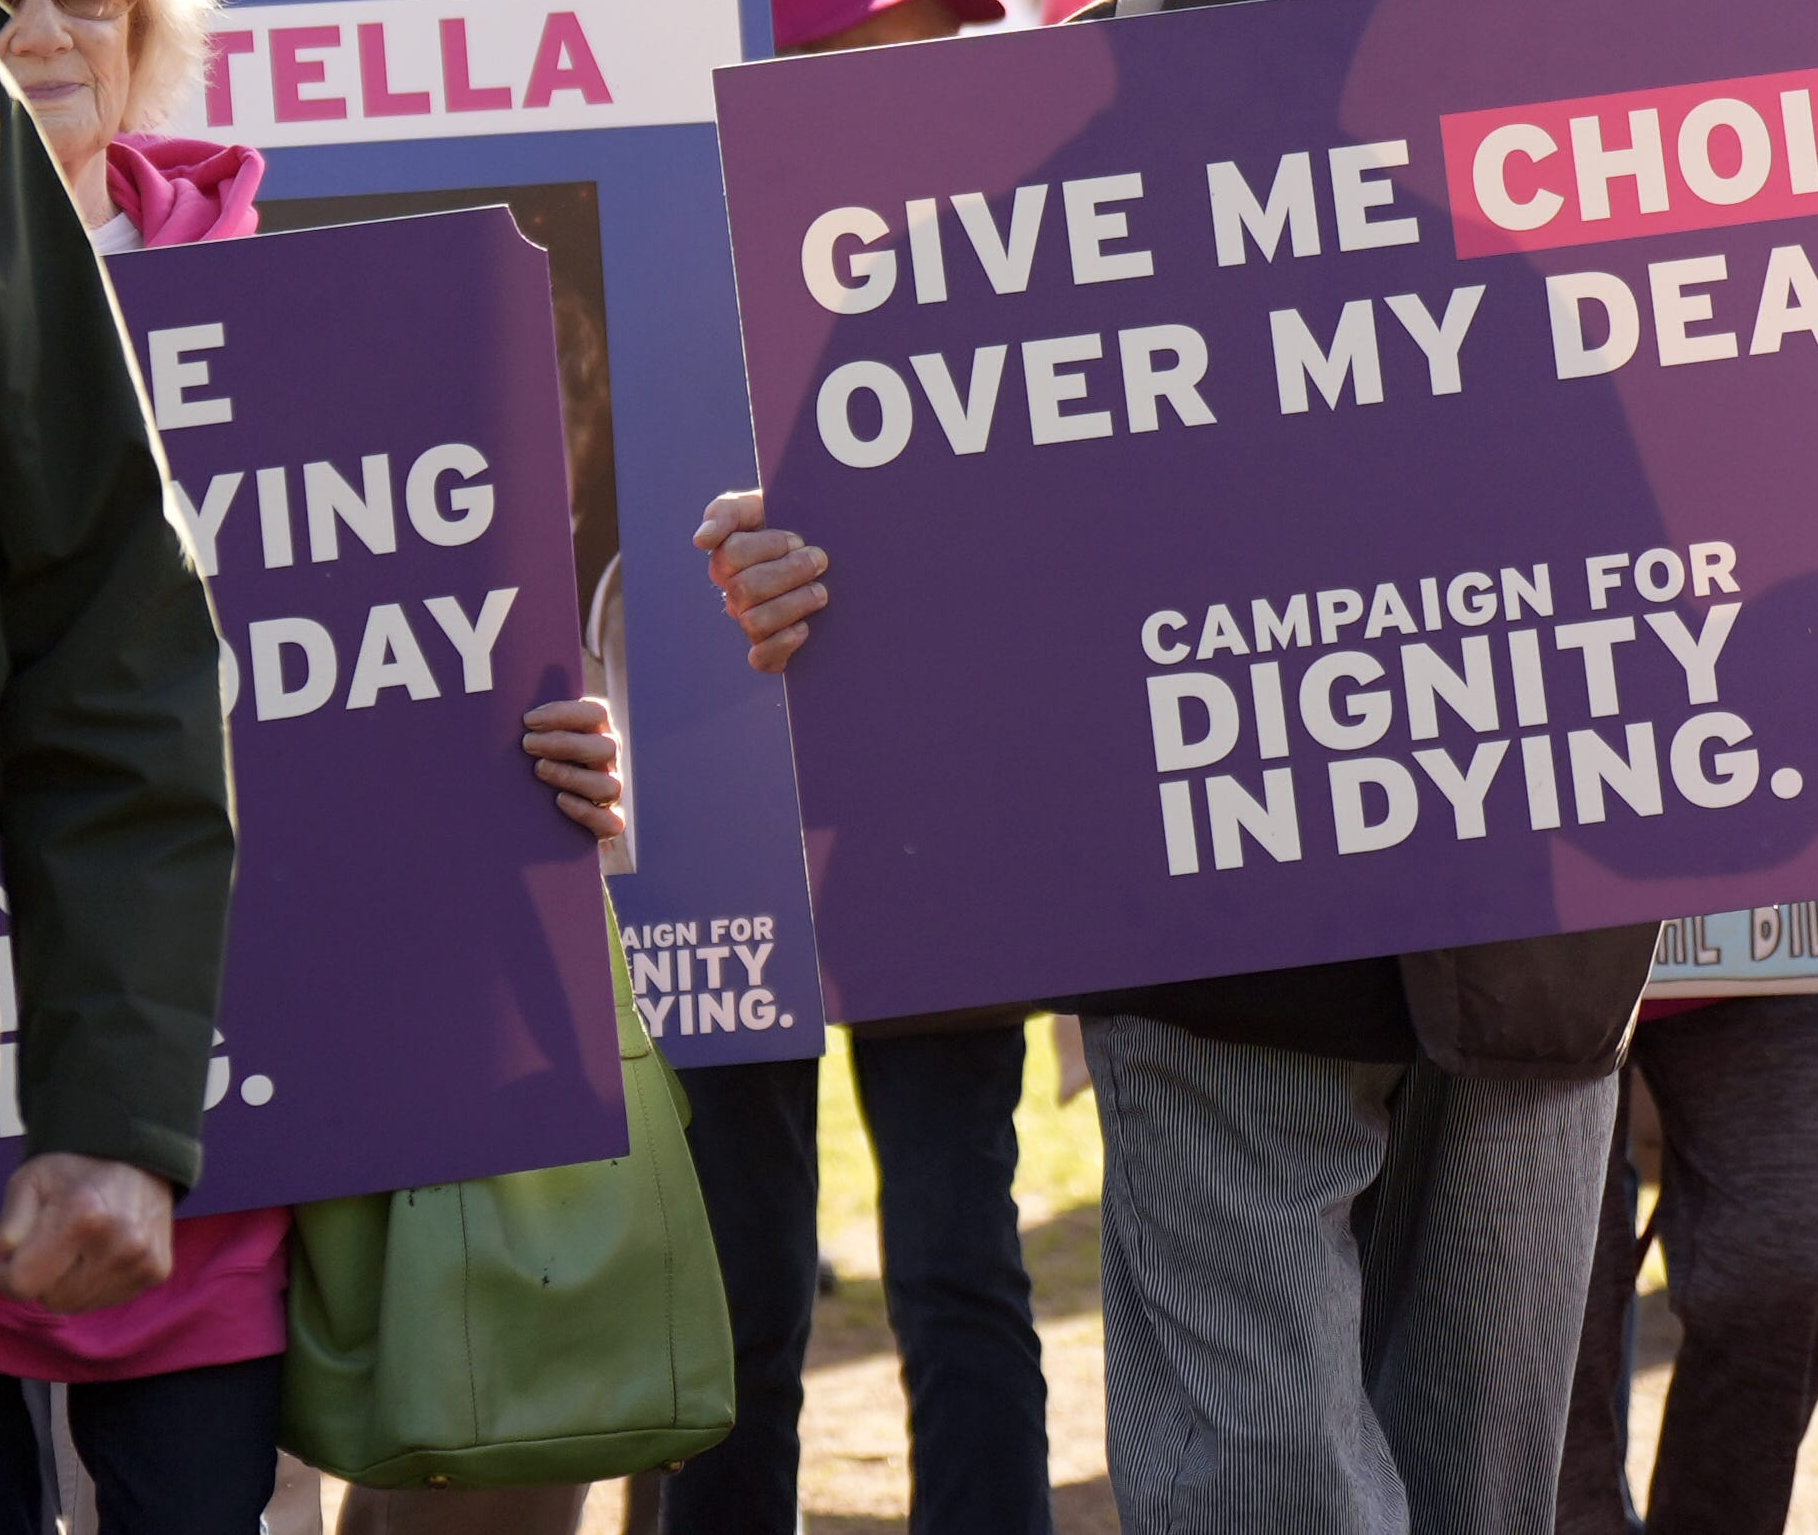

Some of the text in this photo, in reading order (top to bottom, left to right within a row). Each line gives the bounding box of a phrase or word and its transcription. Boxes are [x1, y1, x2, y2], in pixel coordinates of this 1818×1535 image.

[207, 10, 614, 129] TELLA
[801, 170, 1153, 314] GIVE
[1206, 139, 1420, 268] ME
[813, 323, 1217, 469] OVER
[1267, 284, 1488, 416] MY
[169, 442, 496, 579] YING
[220, 587, 520, 723] DAY
[1139, 539, 1742, 666] CAMPAIGN FOR
[1144, 602, 1745, 774] DIGNITY
[1157, 712, 1805, 877] IN DYING.
[621, 916, 774, 950] AIGN FOR
[630, 942, 775, 996] NITY
[635, 988, 795, 1038] YING.
